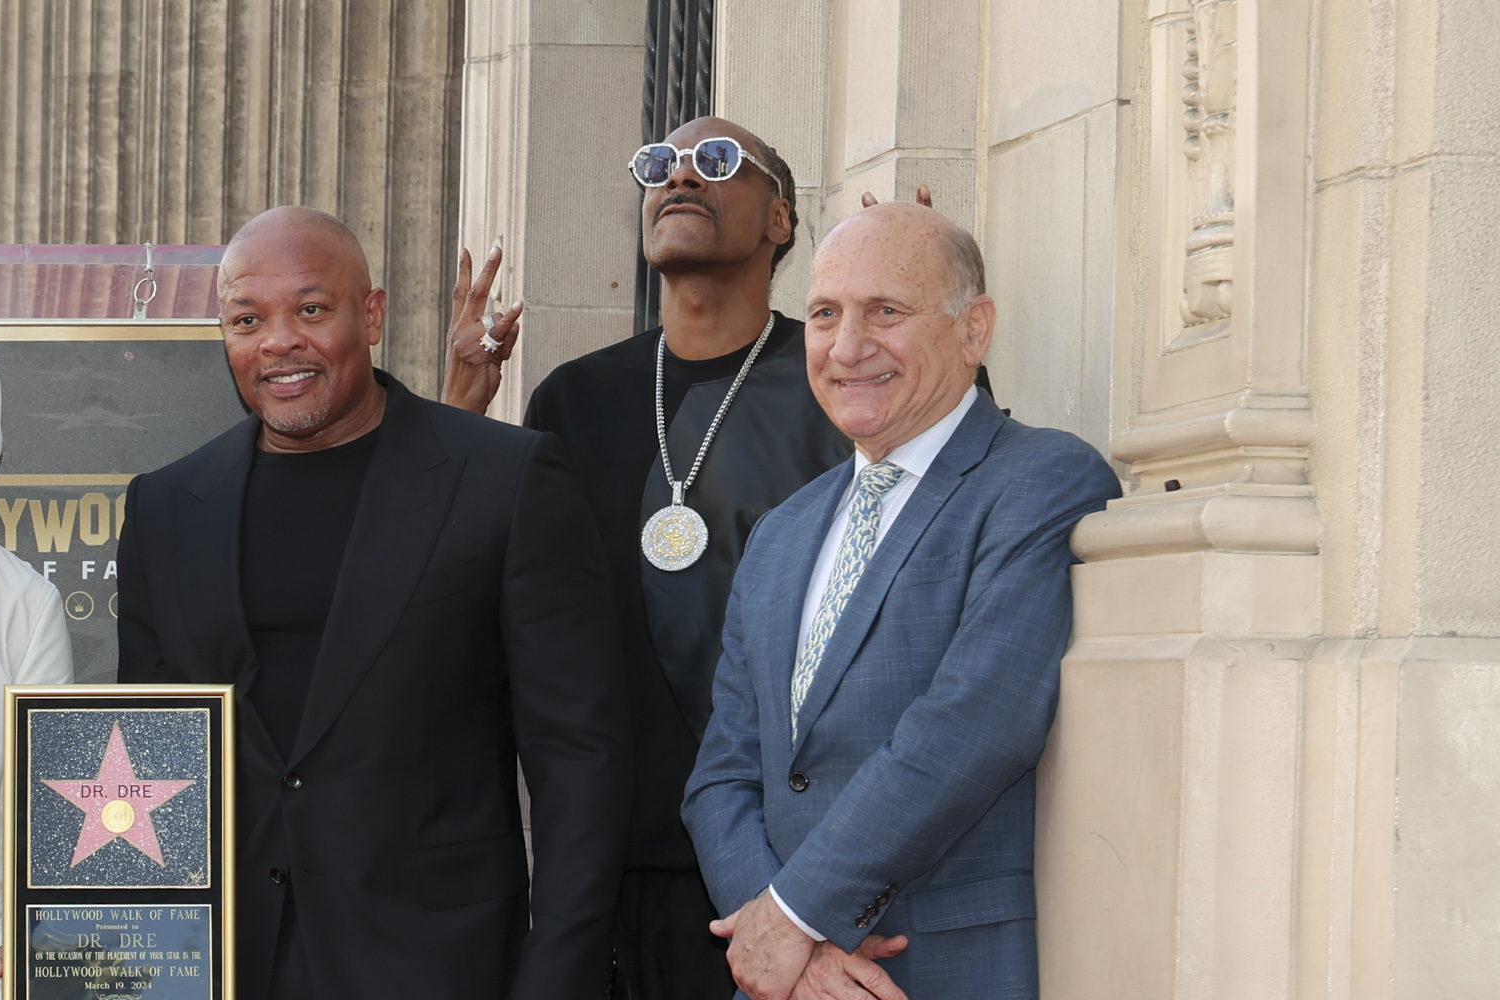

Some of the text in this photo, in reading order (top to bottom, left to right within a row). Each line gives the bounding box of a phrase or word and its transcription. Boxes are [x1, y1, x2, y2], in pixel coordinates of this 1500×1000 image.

[81, 784, 153, 798] DR. DRE
[35, 908, 201, 921] HOLLYWOOD WALK OF FAME
[77, 933, 157, 948] DR. DRE
[35, 951, 202, 960] ON THE OCCASION OF THE PLACEMENT OF YOUR STAR IN THE
[34, 965, 200, 978] HOLLYWOOD WALK OF FAME
[84, 981, 110, 990] March
[130, 981, 153, 990] 2024
